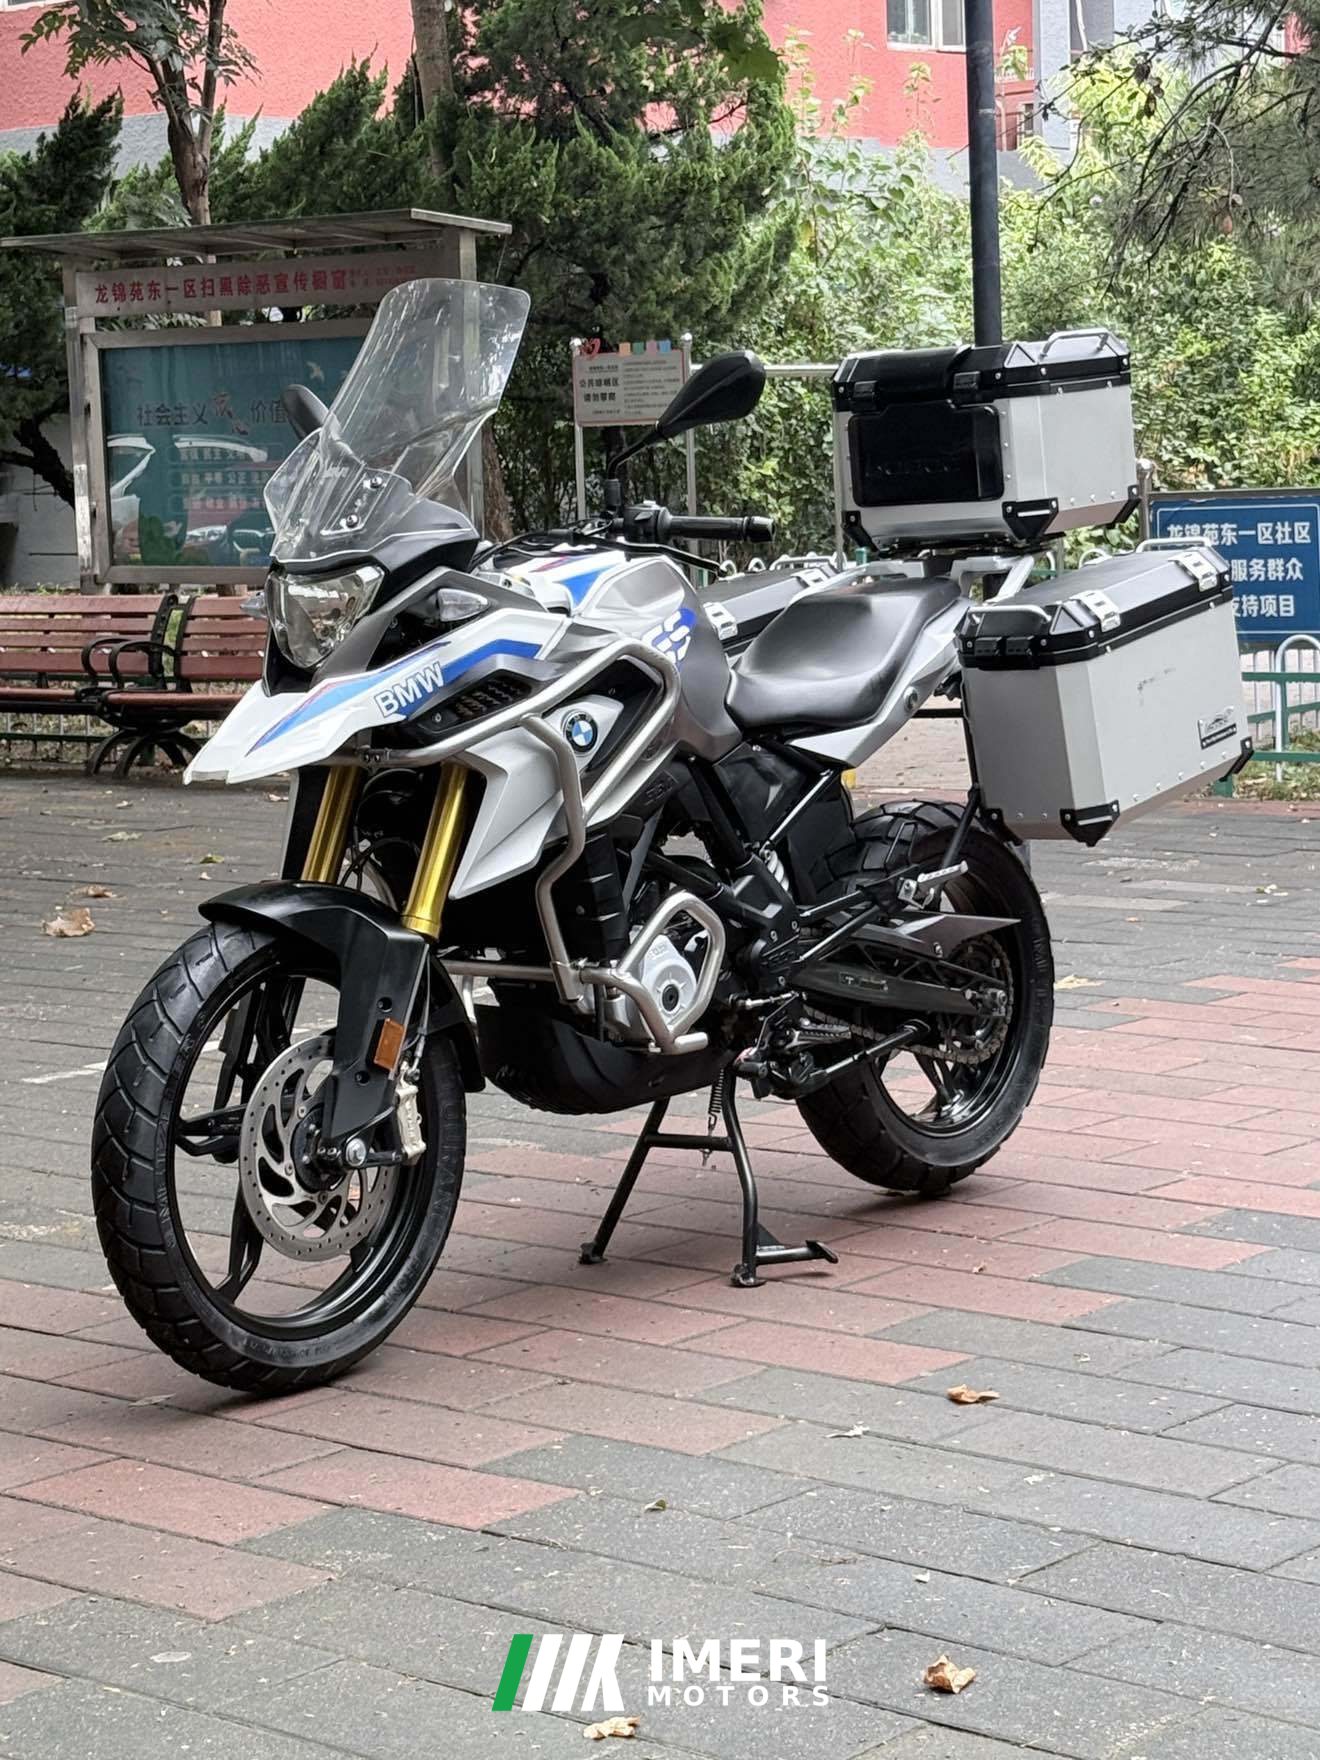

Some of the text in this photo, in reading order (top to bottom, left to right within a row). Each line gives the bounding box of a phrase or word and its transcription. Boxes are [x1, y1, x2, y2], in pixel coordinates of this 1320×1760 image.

[1228, 557, 1304, 582] 服务群众
[374, 660, 445, 718] BMW
